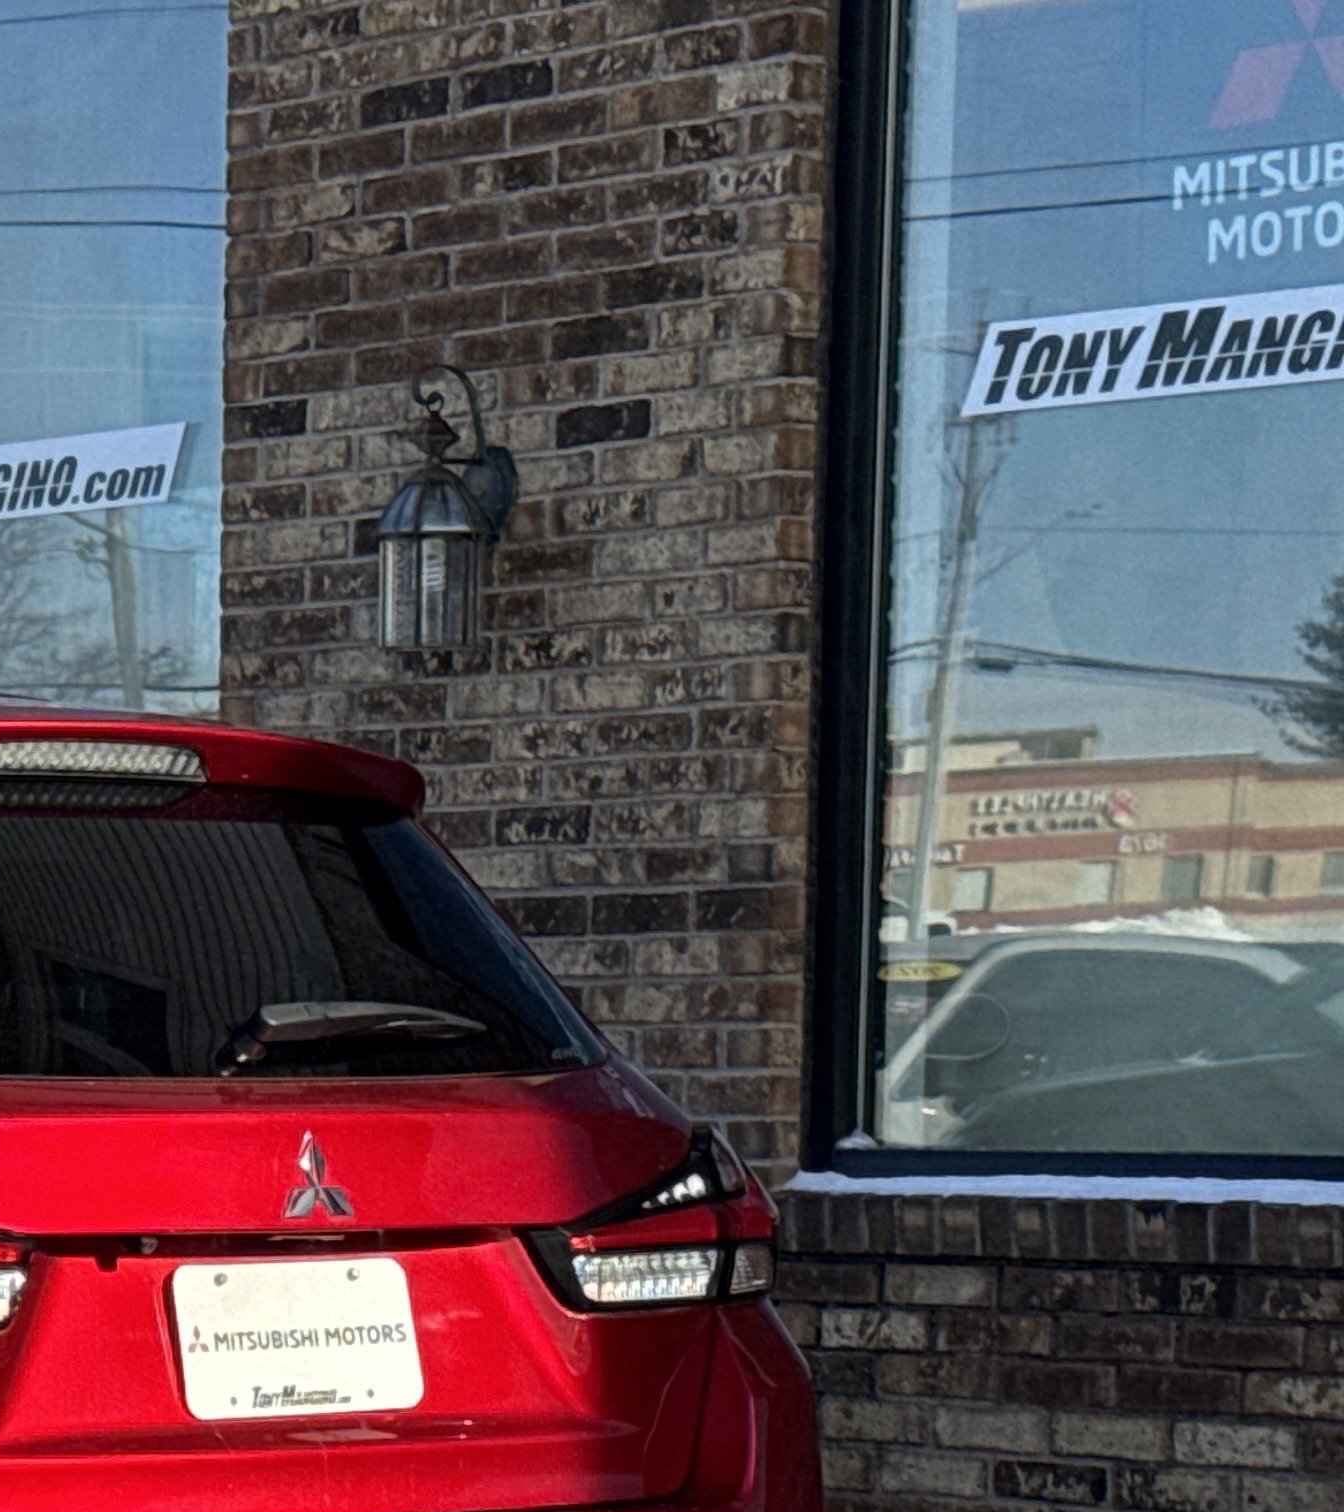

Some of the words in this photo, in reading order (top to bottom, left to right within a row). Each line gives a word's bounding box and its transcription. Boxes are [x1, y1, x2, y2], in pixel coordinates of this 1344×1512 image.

[1208, 201, 1344, 264] MOTO
[213, 1329, 319, 1352] MITSUBISHI
[324, 1323, 407, 1347] MOTORS
